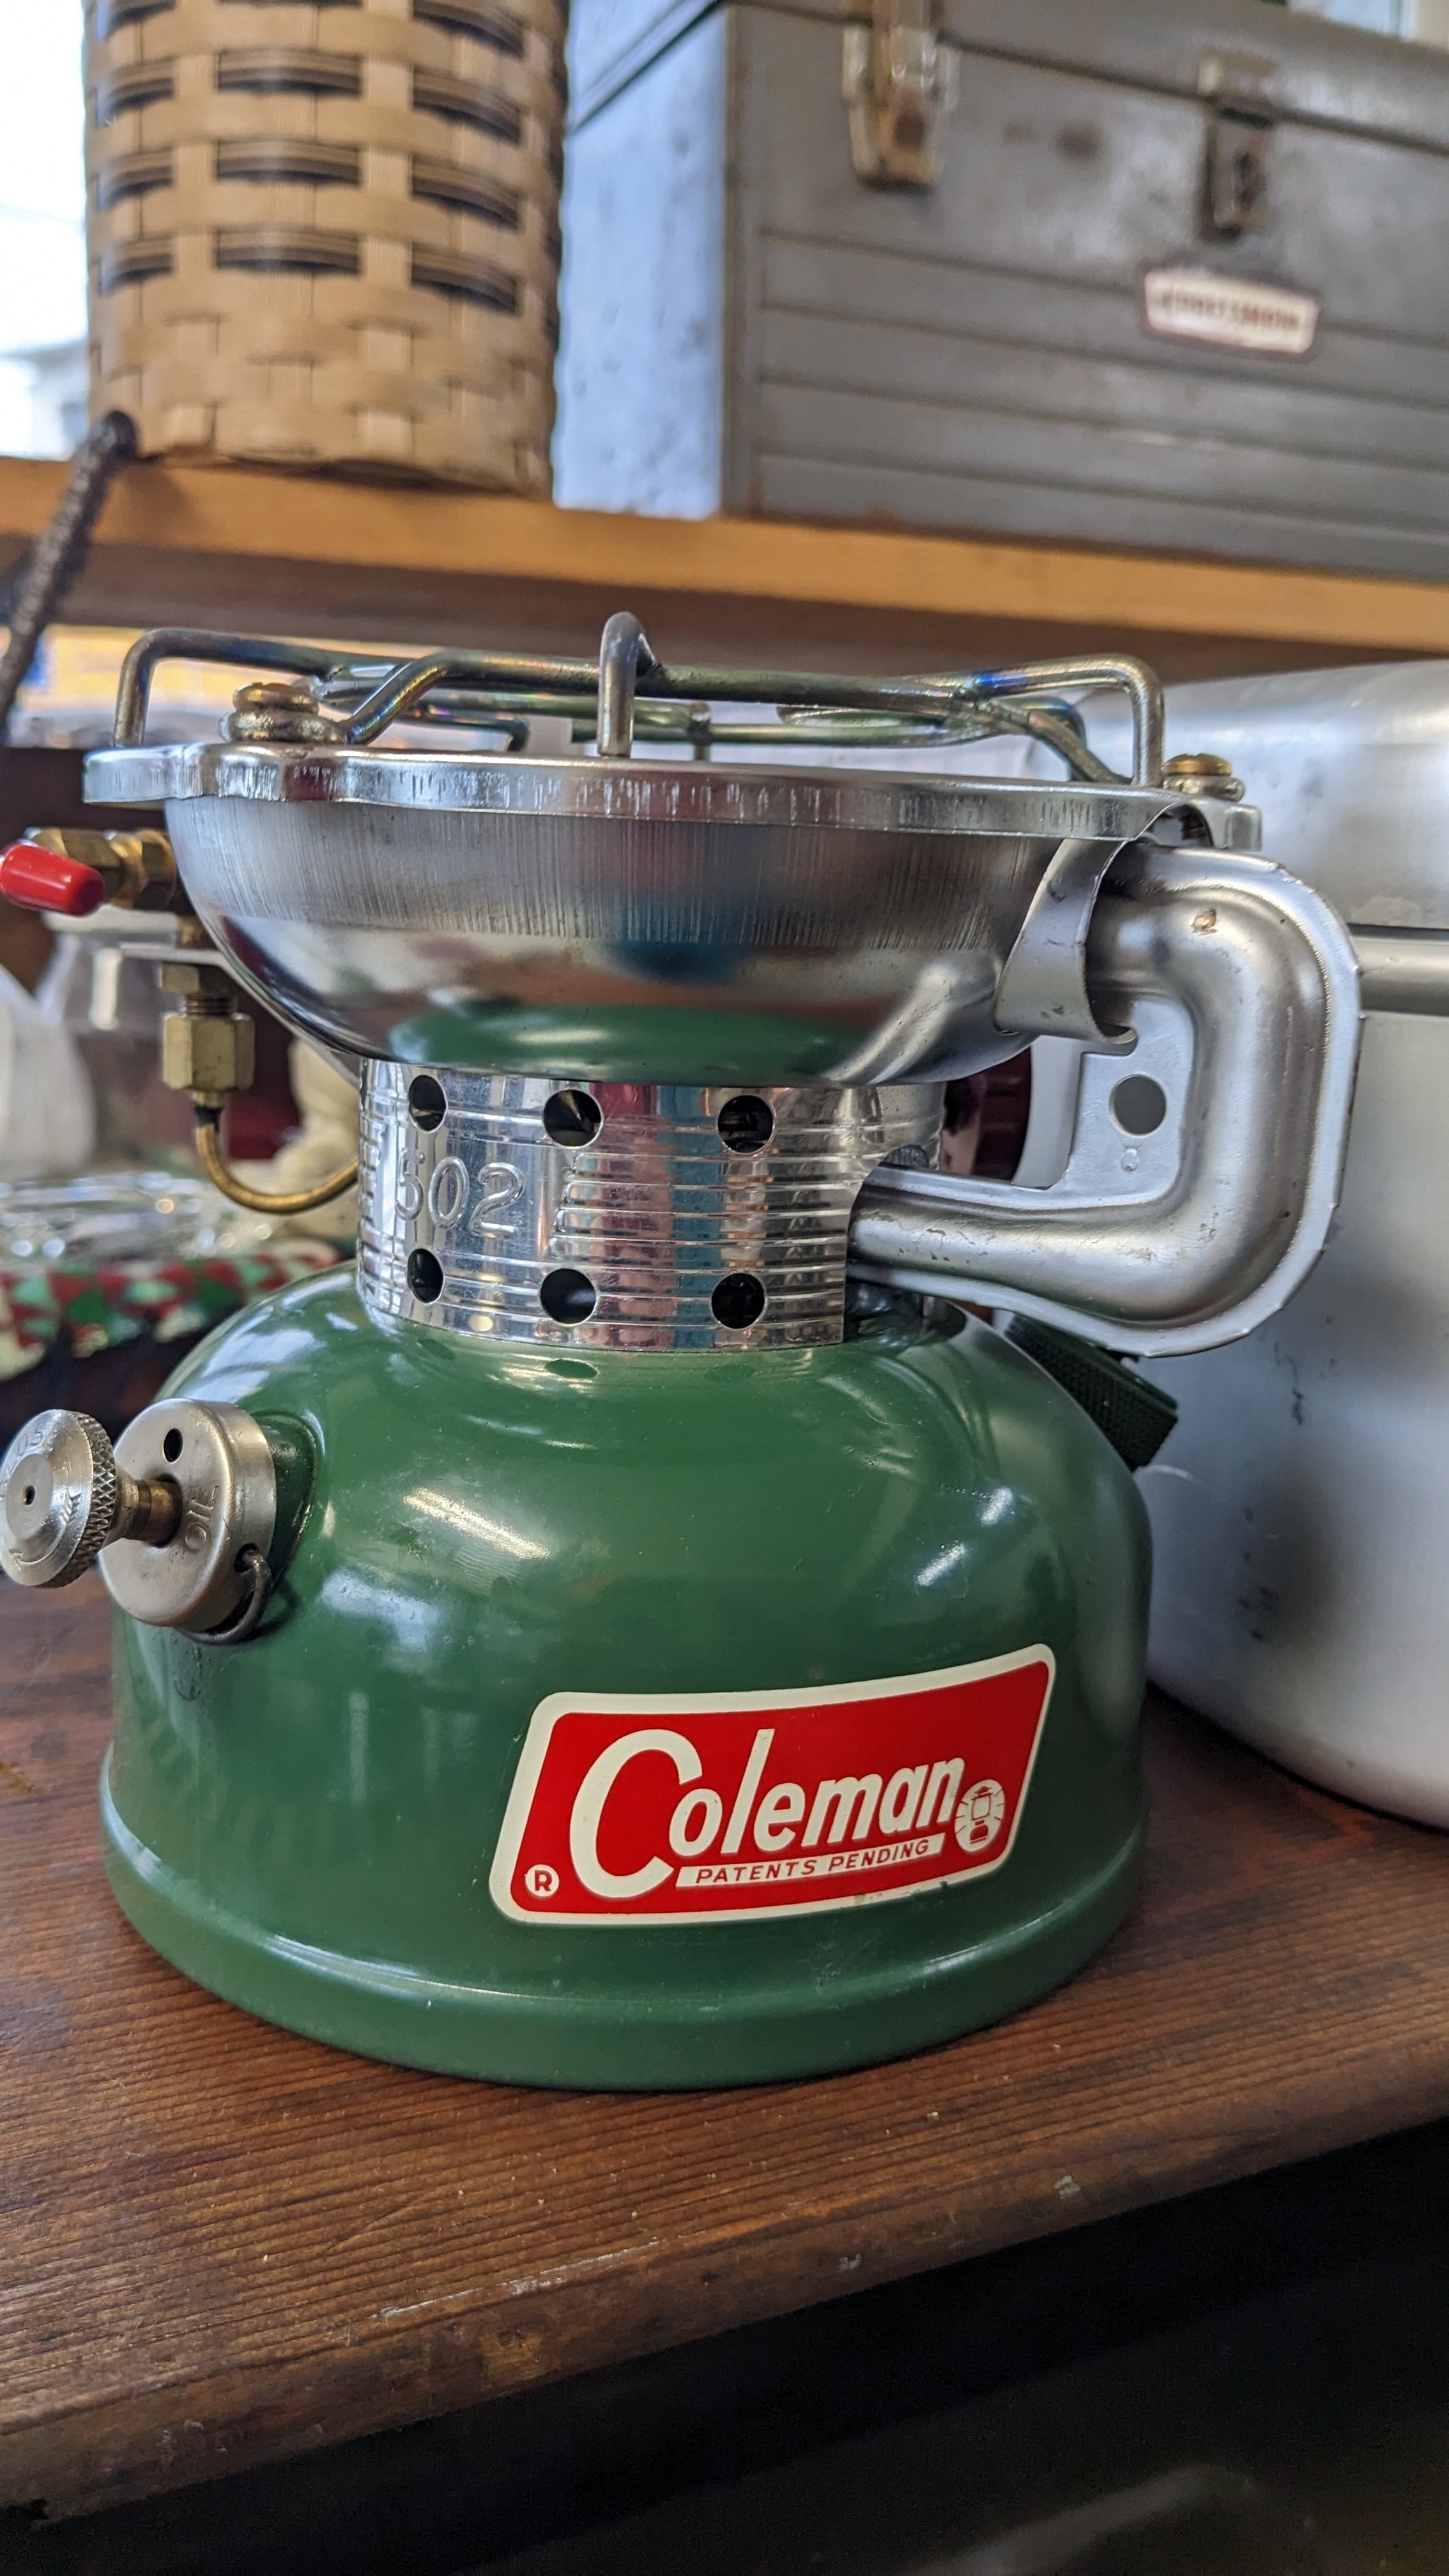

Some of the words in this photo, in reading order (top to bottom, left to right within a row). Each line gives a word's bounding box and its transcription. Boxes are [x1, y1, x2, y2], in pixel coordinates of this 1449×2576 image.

[395, 1147, 525, 1239] 502
[569, 1728, 965, 1899] Coleman
[695, 1859, 818, 1883] PATENTS
[828, 1838, 929, 1871] PENDING
